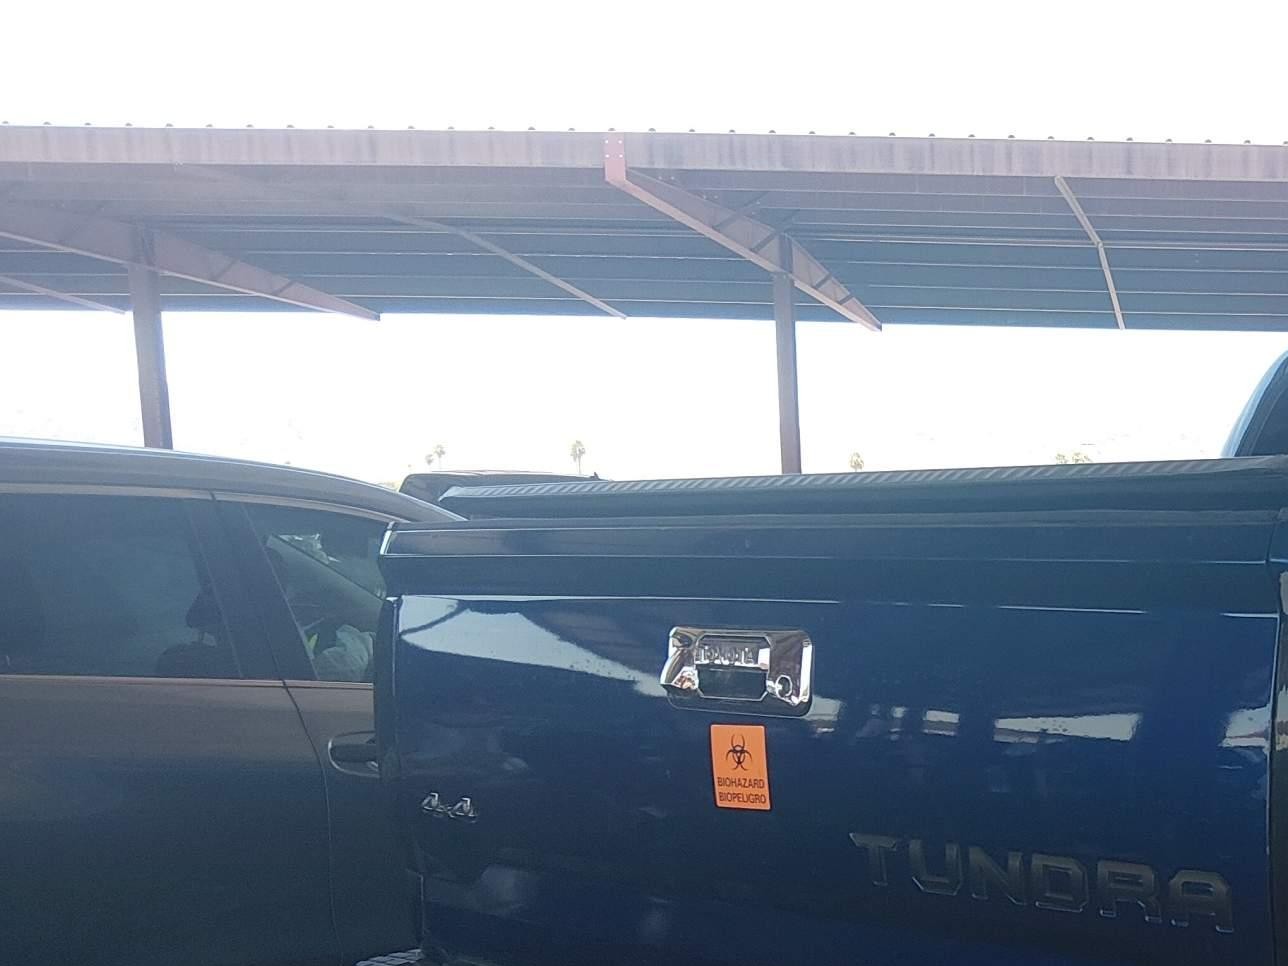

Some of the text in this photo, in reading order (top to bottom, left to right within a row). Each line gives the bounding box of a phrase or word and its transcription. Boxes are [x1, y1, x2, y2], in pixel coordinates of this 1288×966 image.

[717, 777, 765, 789] BIOHAZARD
[718, 791, 767, 804] BIOPELIGRO
[848, 832, 1235, 933] TUNDRA
